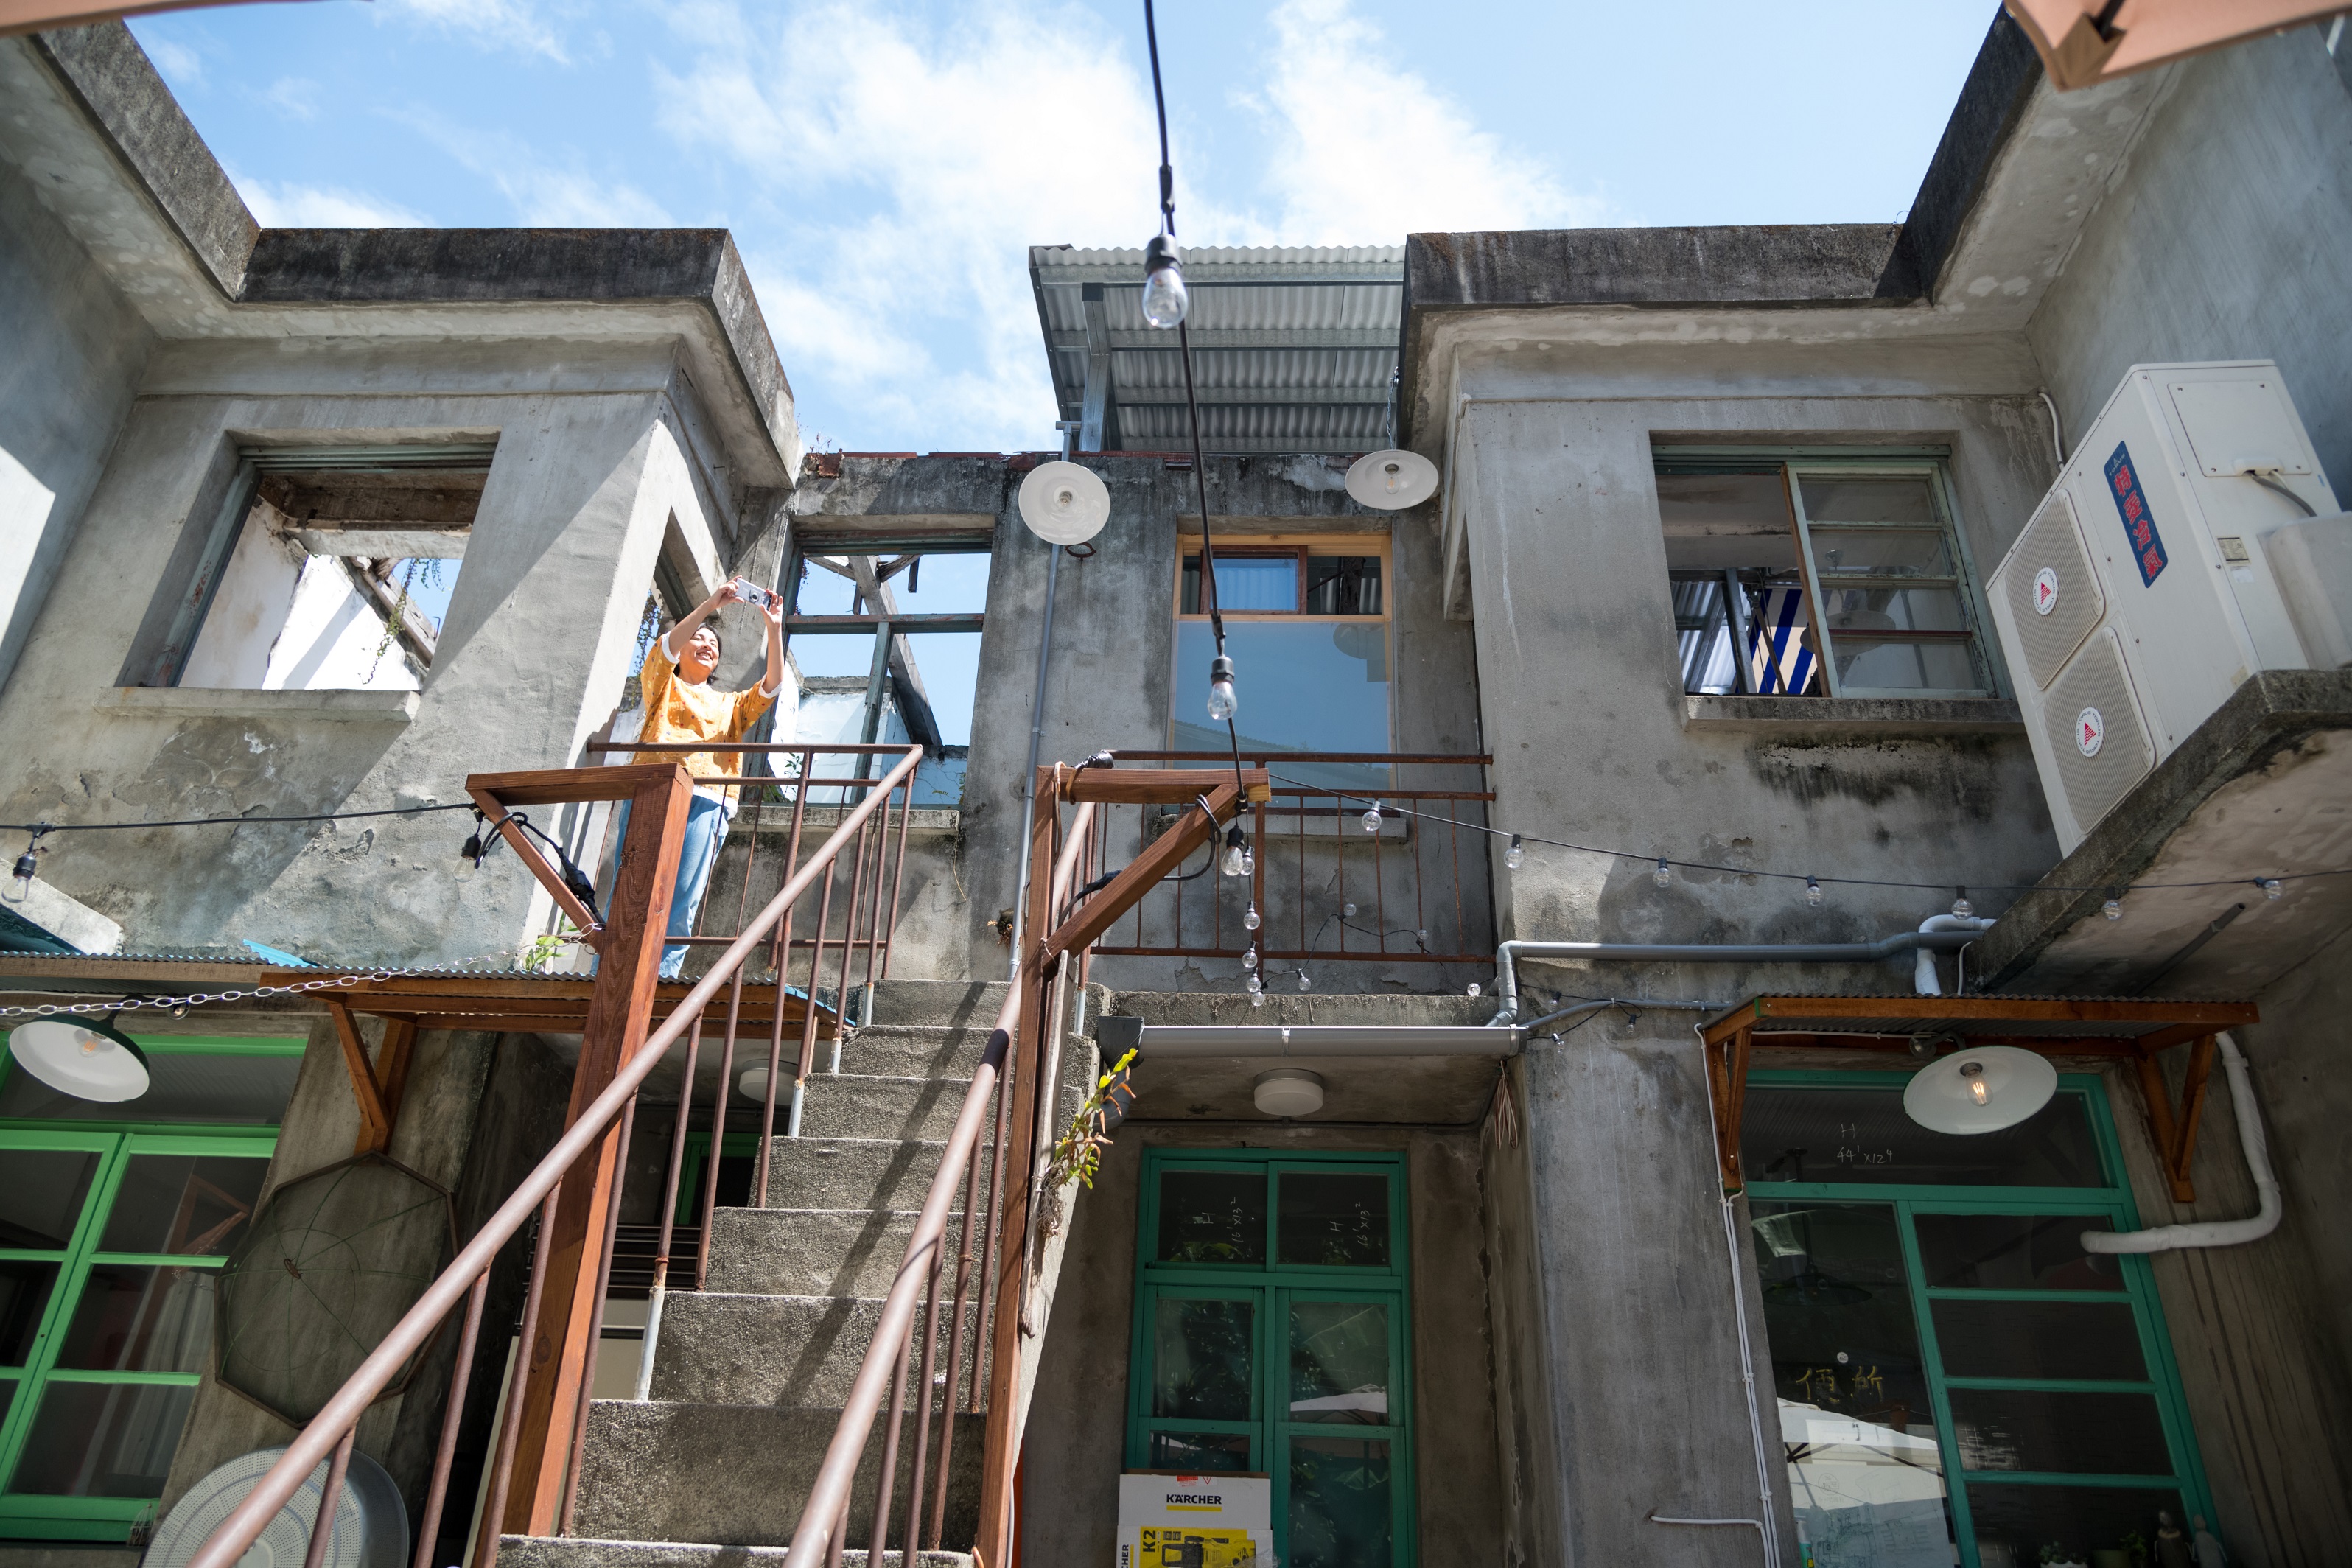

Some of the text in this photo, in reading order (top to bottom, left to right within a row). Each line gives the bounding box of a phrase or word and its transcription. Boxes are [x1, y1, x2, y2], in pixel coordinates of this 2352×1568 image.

[2113, 464, 2163, 580] 特菱冷氣
[1841, 1123, 1855, 1139] H
[1166, 1494, 1222, 1505] KÄRCHER
